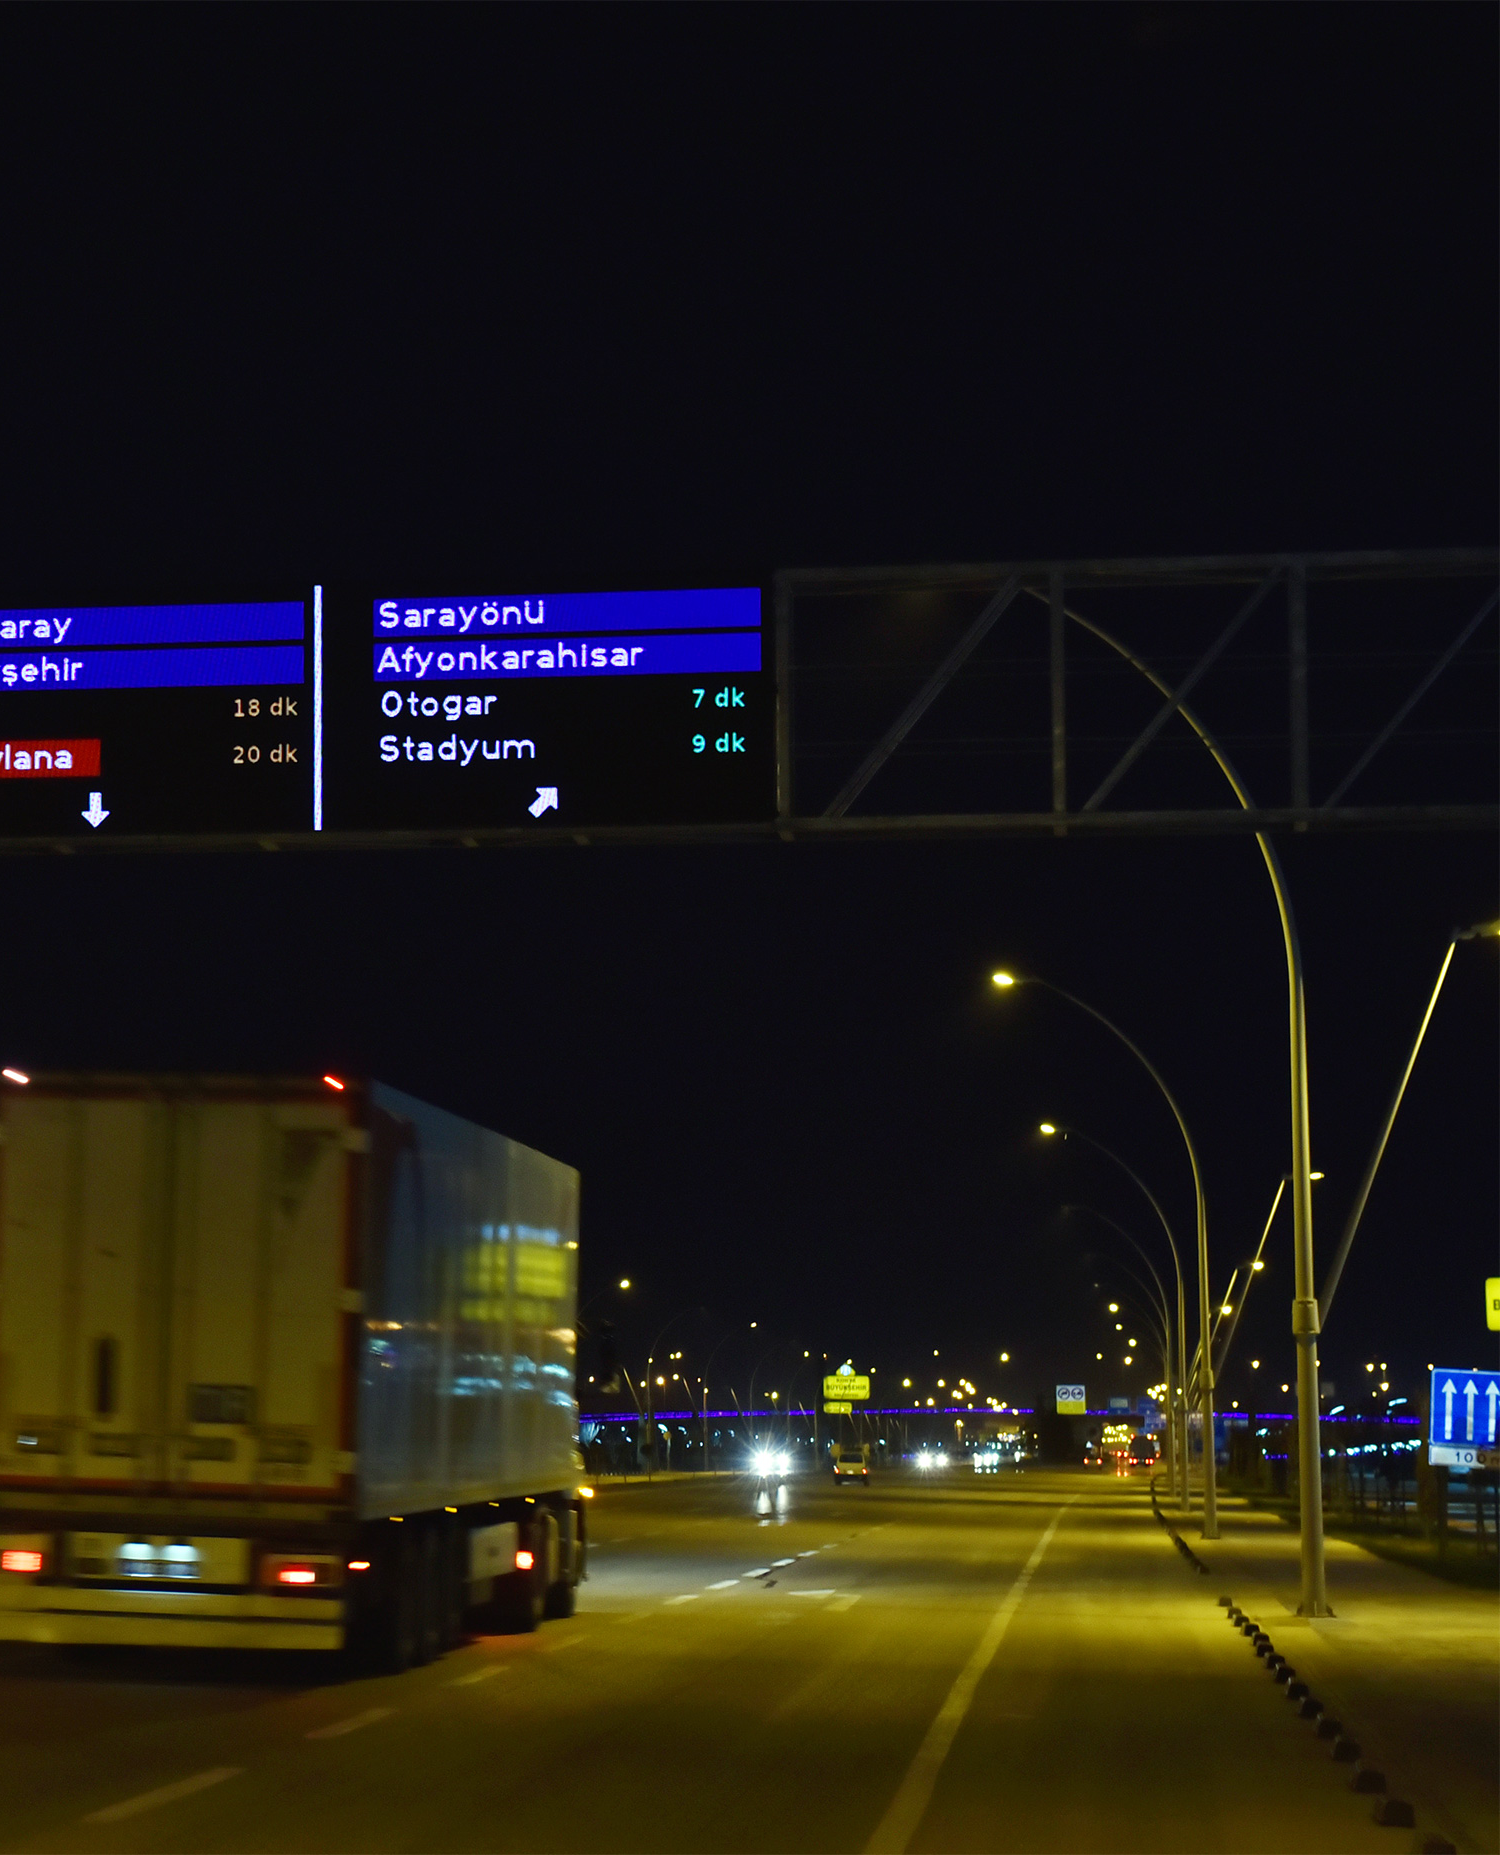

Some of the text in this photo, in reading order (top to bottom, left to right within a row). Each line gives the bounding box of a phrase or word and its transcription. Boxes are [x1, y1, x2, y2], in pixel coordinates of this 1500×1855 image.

[379, 599, 544, 633] Sarayönü
[377, 641, 644, 679] Afyonkarahisar
[234, 698, 260, 718] 18
[270, 696, 298, 716] dk
[381, 686, 746, 721] Otogar 7 dk
[233, 745, 260, 764] 20
[270, 743, 298, 763] dk
[379, 731, 746, 767] Stadyum 9 dk
[1456, 1452, 1486, 1464] 100
